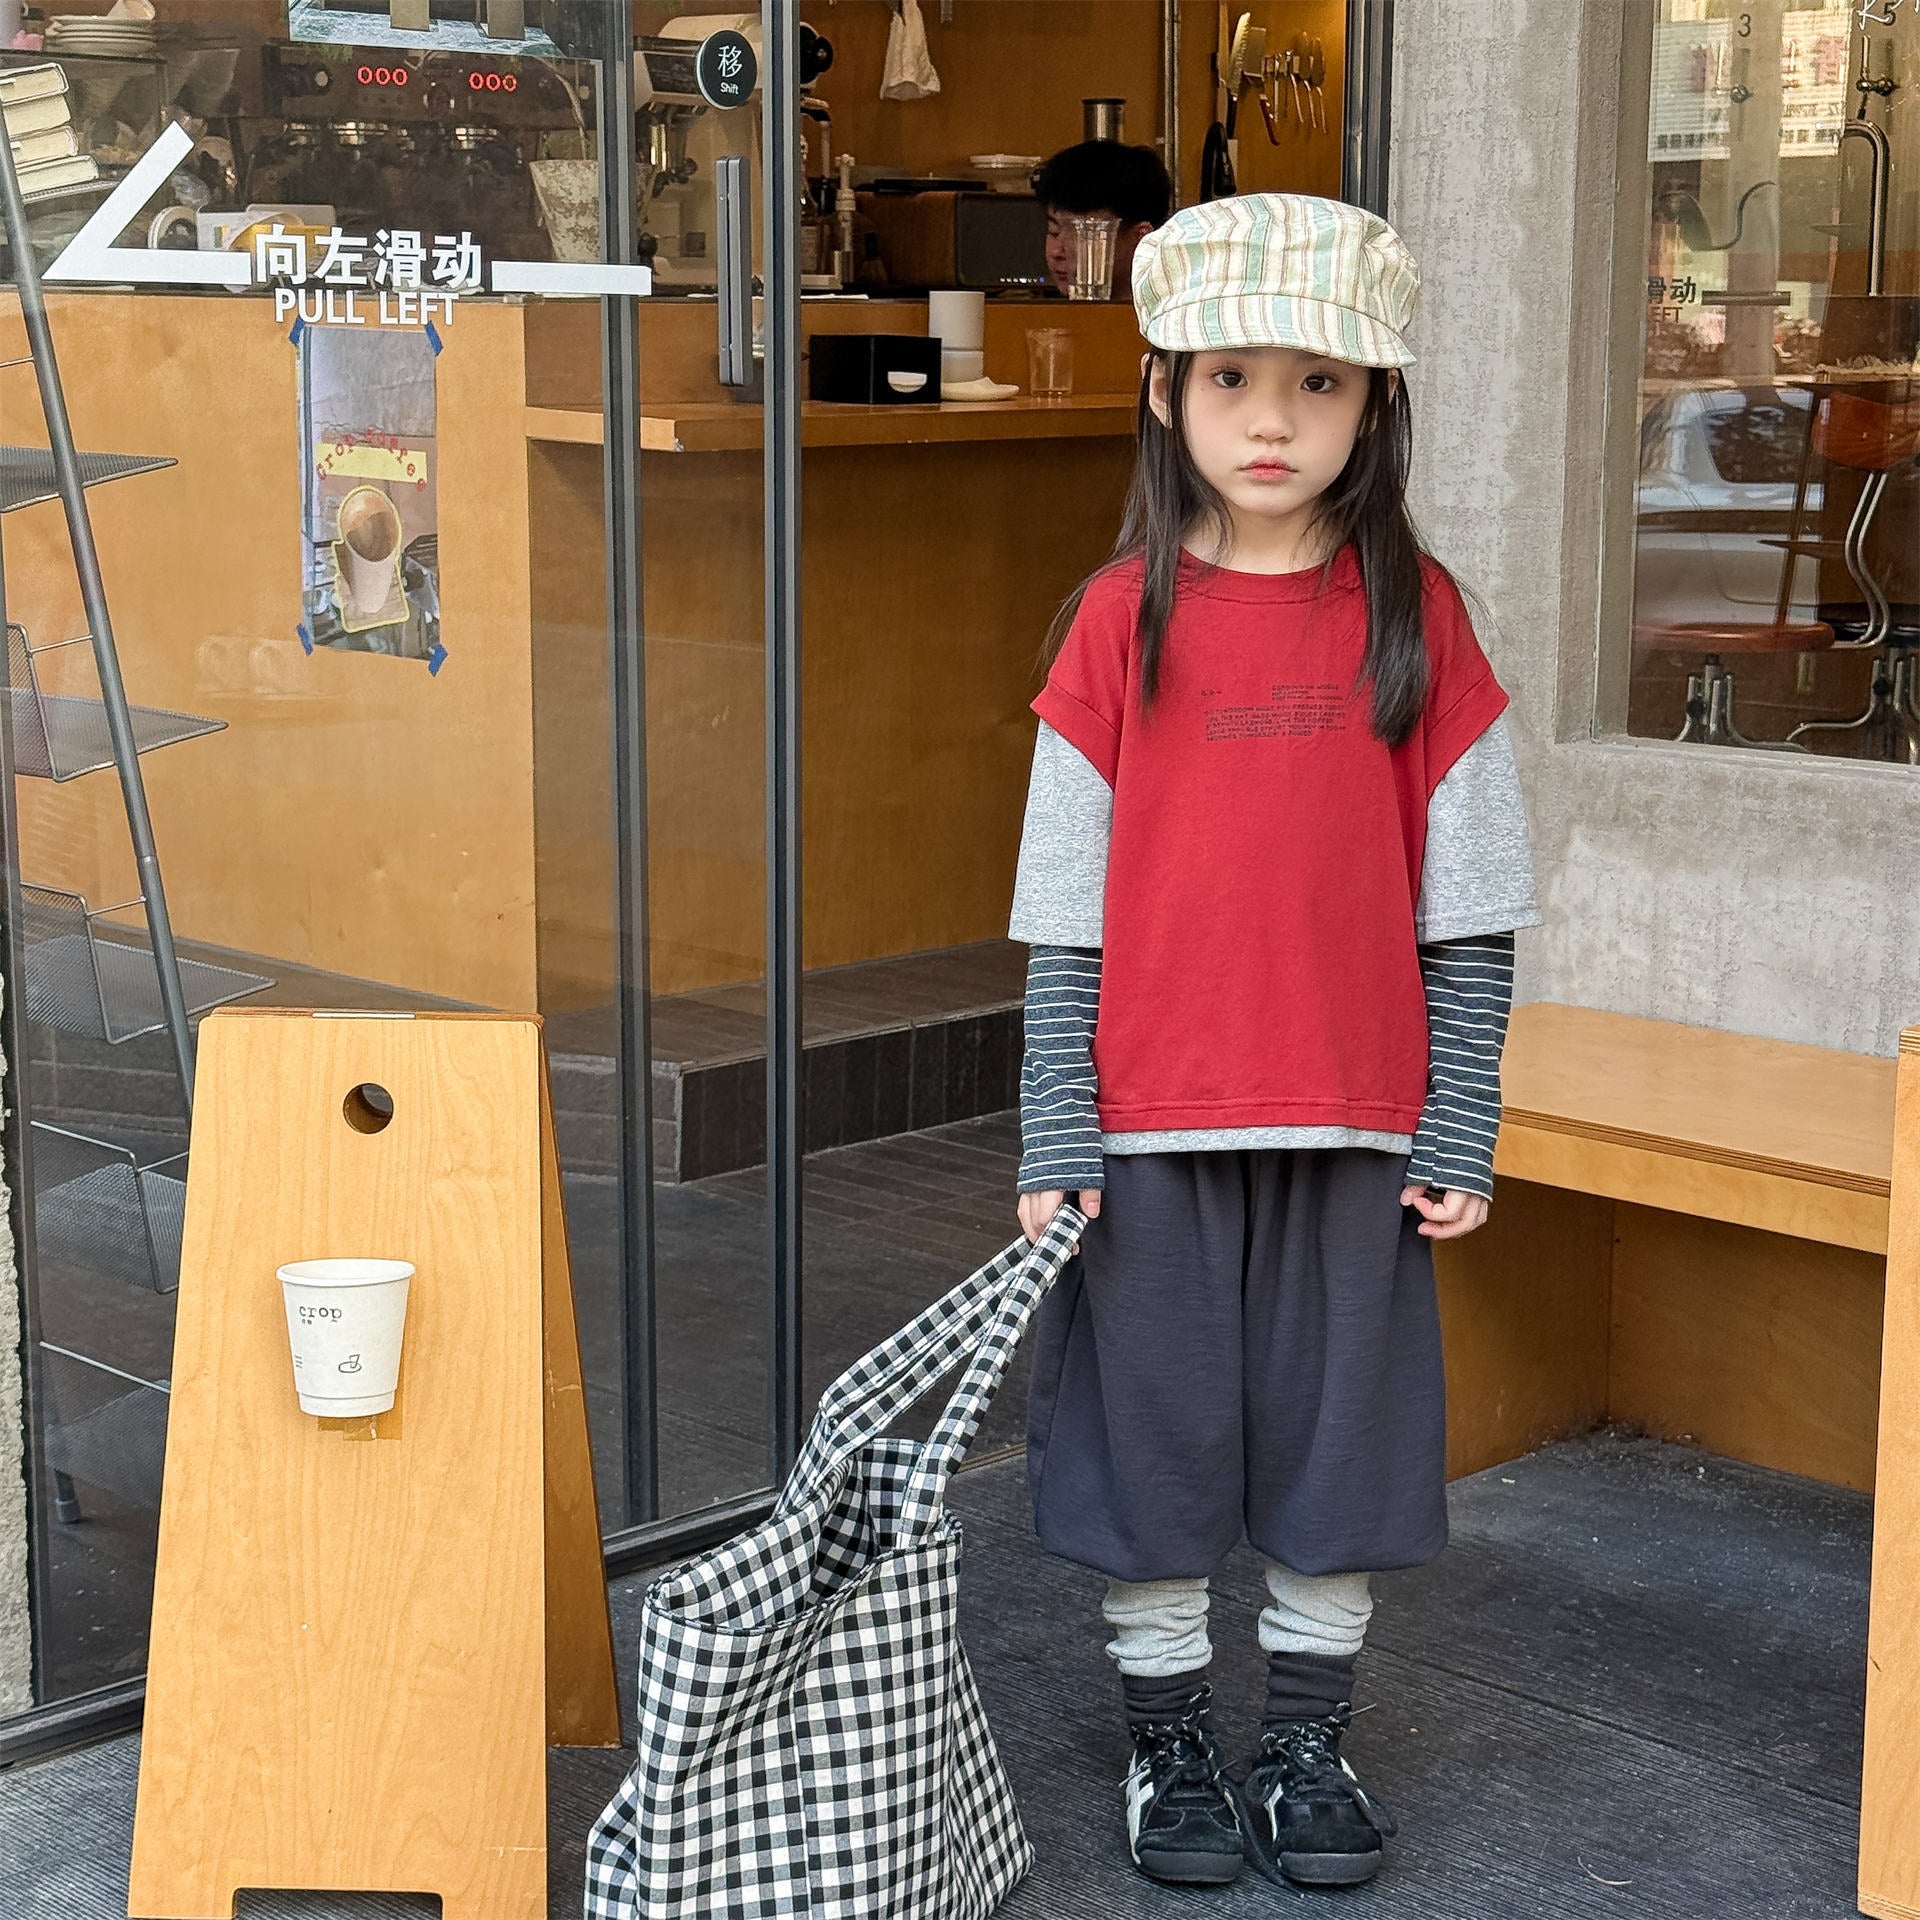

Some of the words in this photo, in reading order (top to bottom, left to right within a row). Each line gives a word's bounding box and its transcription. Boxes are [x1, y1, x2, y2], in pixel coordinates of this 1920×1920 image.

[1738, 14, 1751, 37] 3
[1883, 2, 1896, 26] 5
[718, 45, 743, 78] 移
[720, 81, 739, 95] Shift
[255, 223, 482, 289] 向左滑动
[275, 287, 365, 324] PULL
[379, 290, 459, 325] LEFT
[299, 1305, 343, 1323] crop
